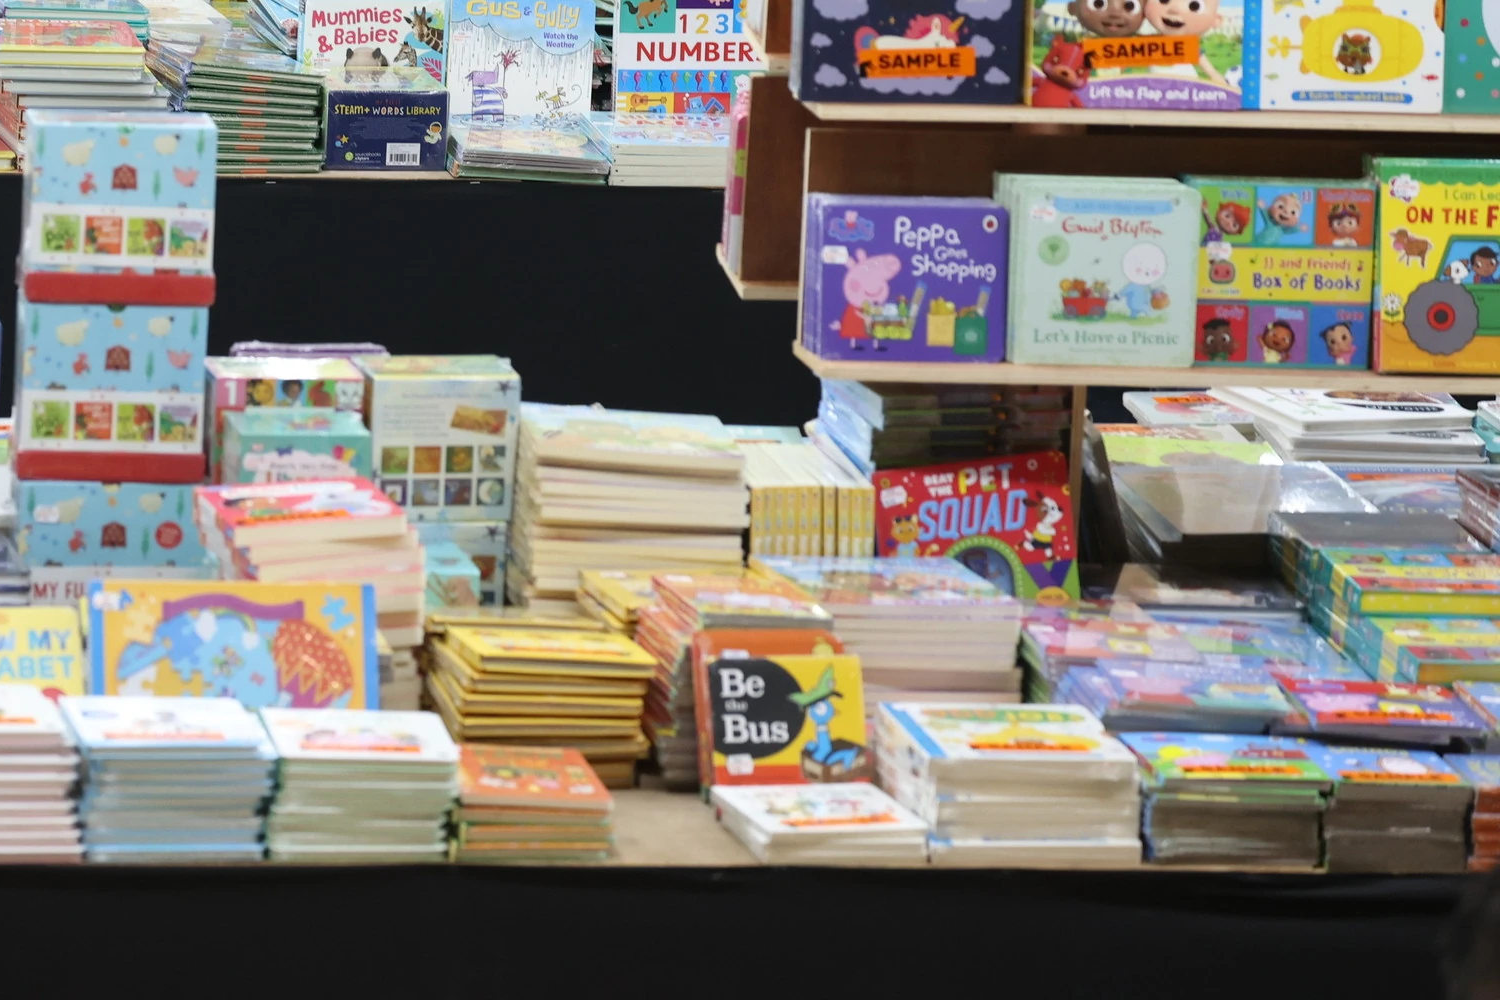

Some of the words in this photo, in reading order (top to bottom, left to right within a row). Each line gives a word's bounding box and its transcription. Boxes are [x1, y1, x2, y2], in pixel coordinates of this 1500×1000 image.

[312, 7, 402, 28] Mummies
[466, 0, 521, 19] GUS
[524, 7, 532, 16] &
[679, 15, 687, 33] 1
[695, 14, 709, 33] 2
[715, 14, 729, 34] 3
[318, 35, 333, 53] &
[334, 28, 398, 44] Babies
[544, 32, 563, 40] Watch
[565, 32, 578, 40] the
[546, 41, 575, 49] Weather
[637, 42, 763, 61] NUMBER
[1103, 42, 1184, 58] SAMPLE
[879, 54, 961, 69] SAMPLE
[334, 104, 370, 114] STEAM+
[372, 107, 404, 116] WORDS
[1406, 206, 1434, 223] ON
[1444, 208, 1478, 224] THE
[894, 216, 960, 249] Peppa
[1062, 217, 1105, 238] Enid
[1111, 218, 1164, 238] Blyton
[934, 246, 968, 260] Goes
[912, 257, 997, 282] Shopping
[1253, 273, 1282, 289] Box
[1289, 273, 1306, 290] of
[1314, 274, 1360, 290] Books
[1034, 328, 1073, 345] Let's
[1078, 330, 1113, 345] Have
[1117, 334, 1126, 345] a
[1134, 328, 1179, 345] Picnic
[959, 463, 1013, 494] PET
[918, 490, 1027, 541] SQUAD
[29, 630, 71, 651] MY
[720, 669, 765, 698] Be
[726, 700, 748, 712] the
[723, 715, 790, 744] Bus
